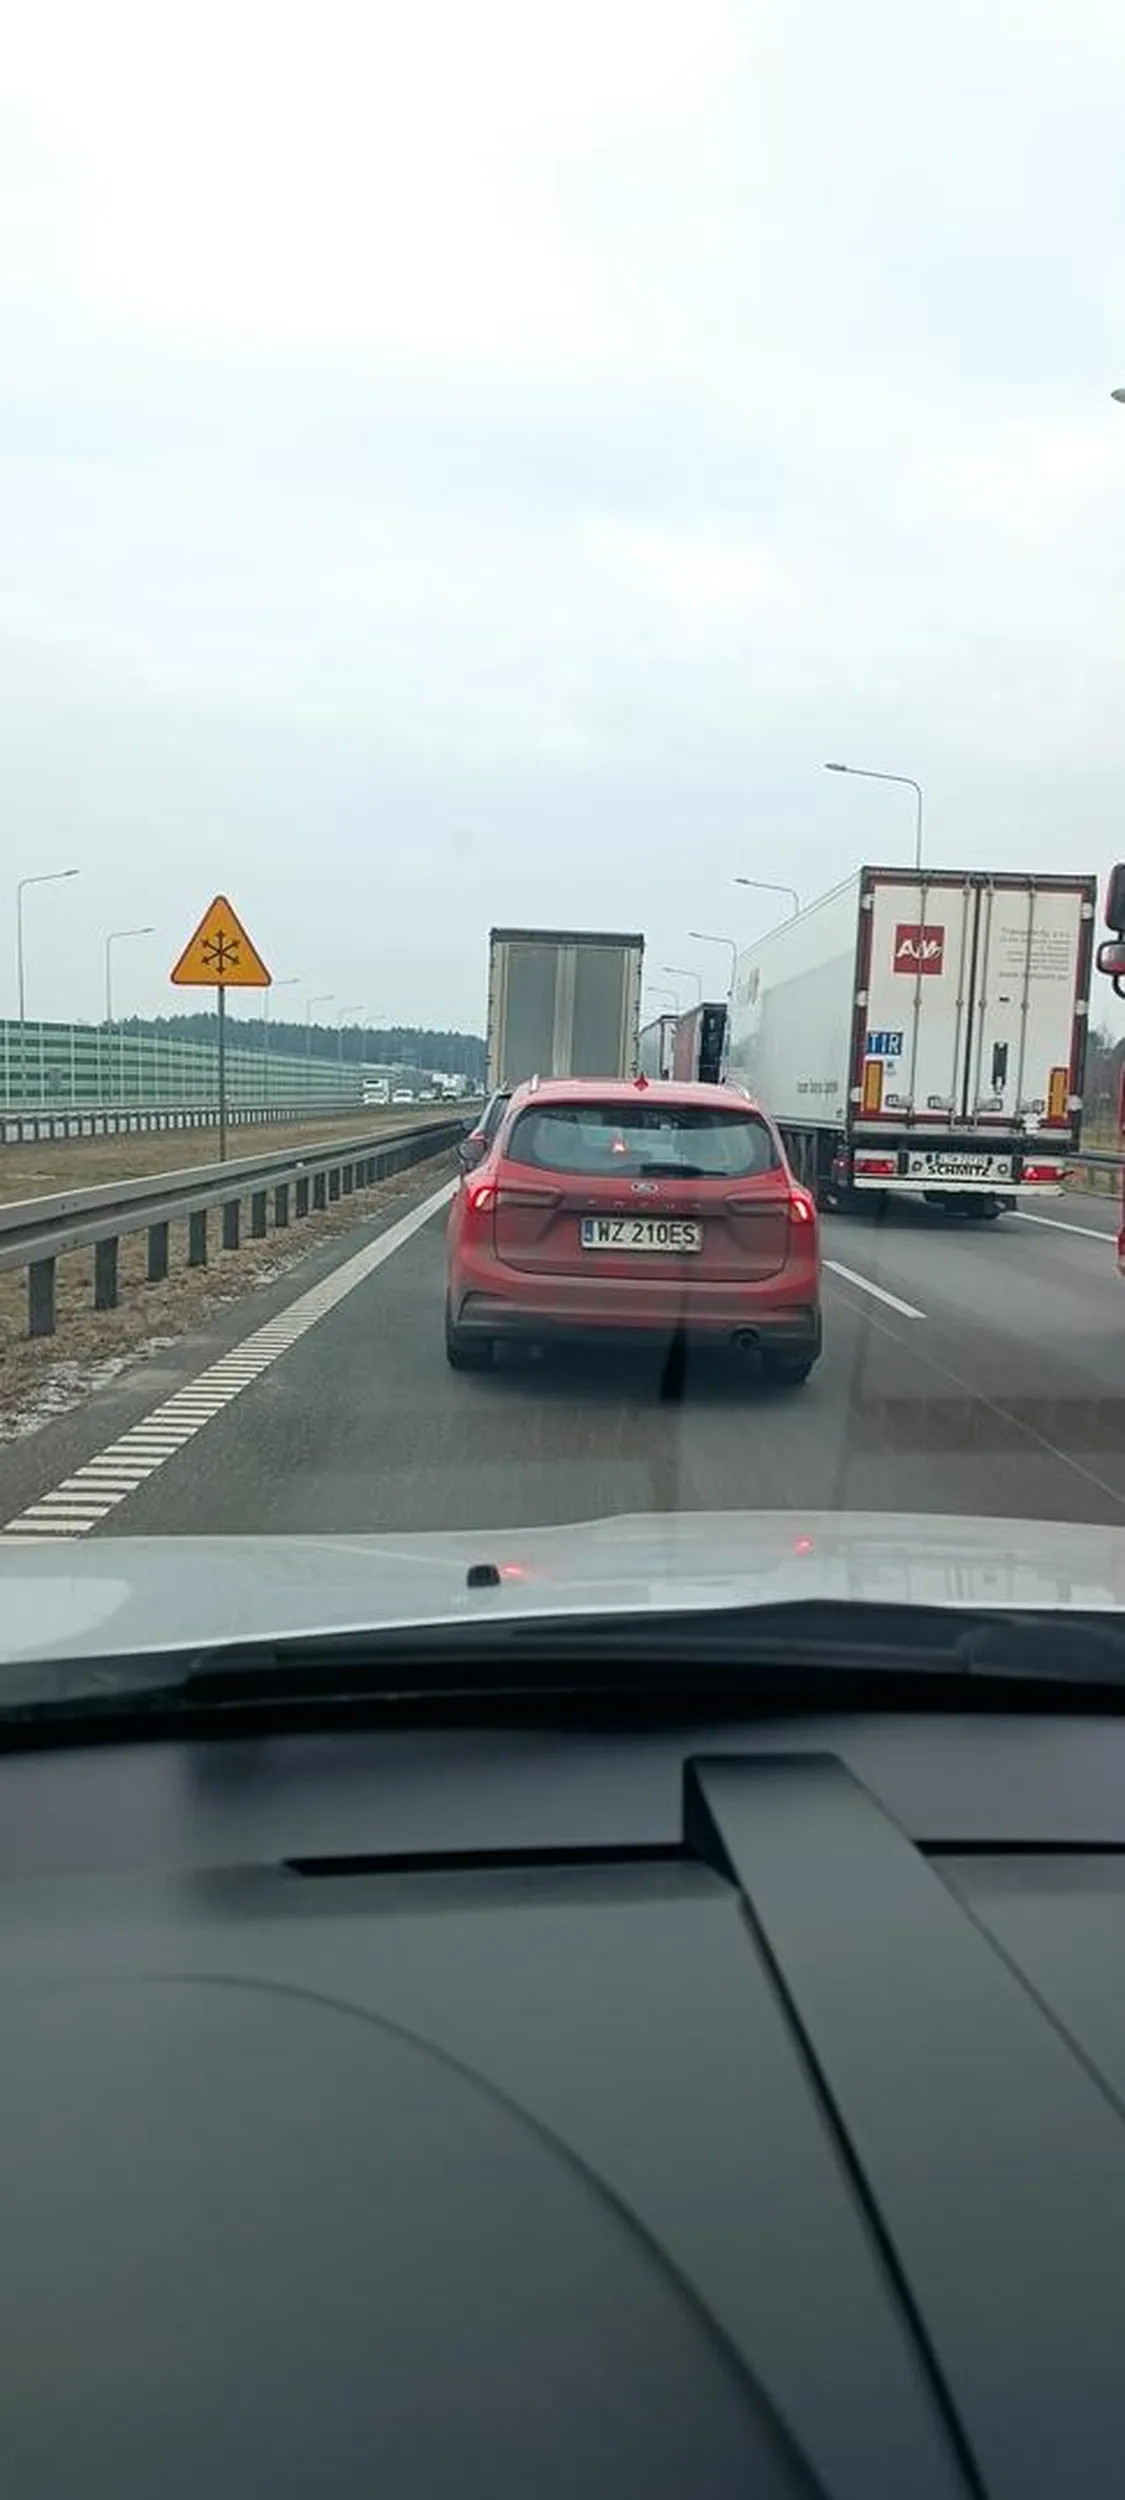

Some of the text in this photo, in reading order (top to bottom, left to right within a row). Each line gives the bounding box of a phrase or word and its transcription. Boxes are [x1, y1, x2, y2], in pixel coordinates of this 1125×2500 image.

[871, 1034, 900, 1054] TIR
[928, 1163, 990, 1176] SCHMITZ
[598, 1221, 695, 1244] WZ 210ES
